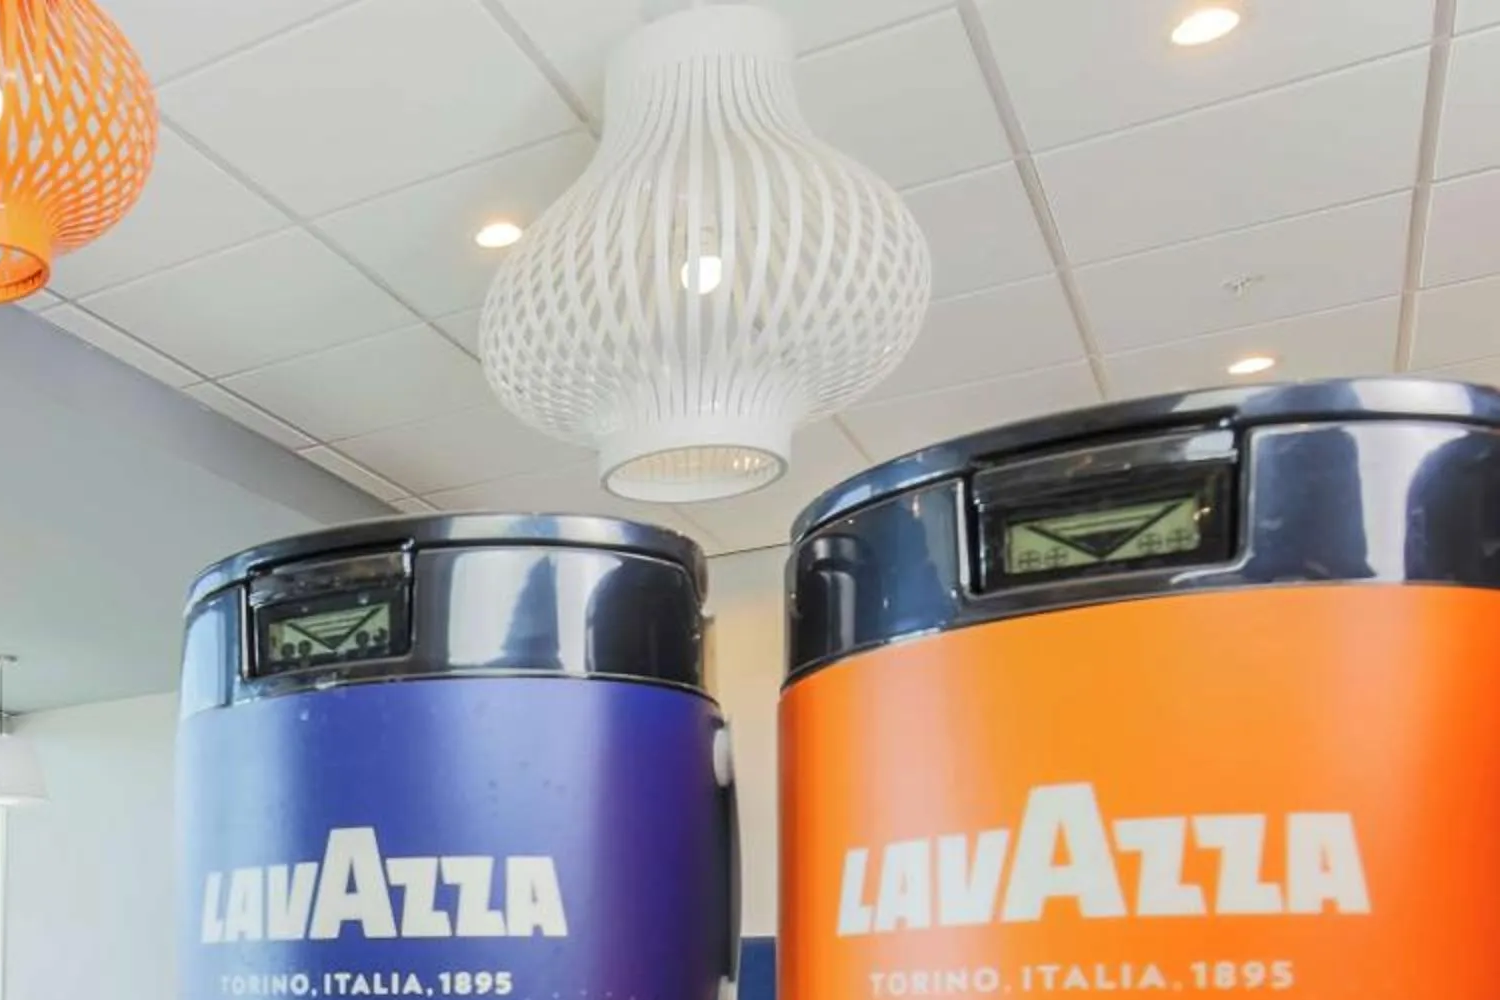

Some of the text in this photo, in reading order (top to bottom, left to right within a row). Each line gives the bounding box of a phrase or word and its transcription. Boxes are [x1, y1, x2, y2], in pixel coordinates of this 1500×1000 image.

[201, 826, 568, 943] LAVAZZA
[836, 782, 1372, 937] LAVAZZA
[438, 971, 514, 995] 1895
[1190, 960, 1295, 990] 1895
